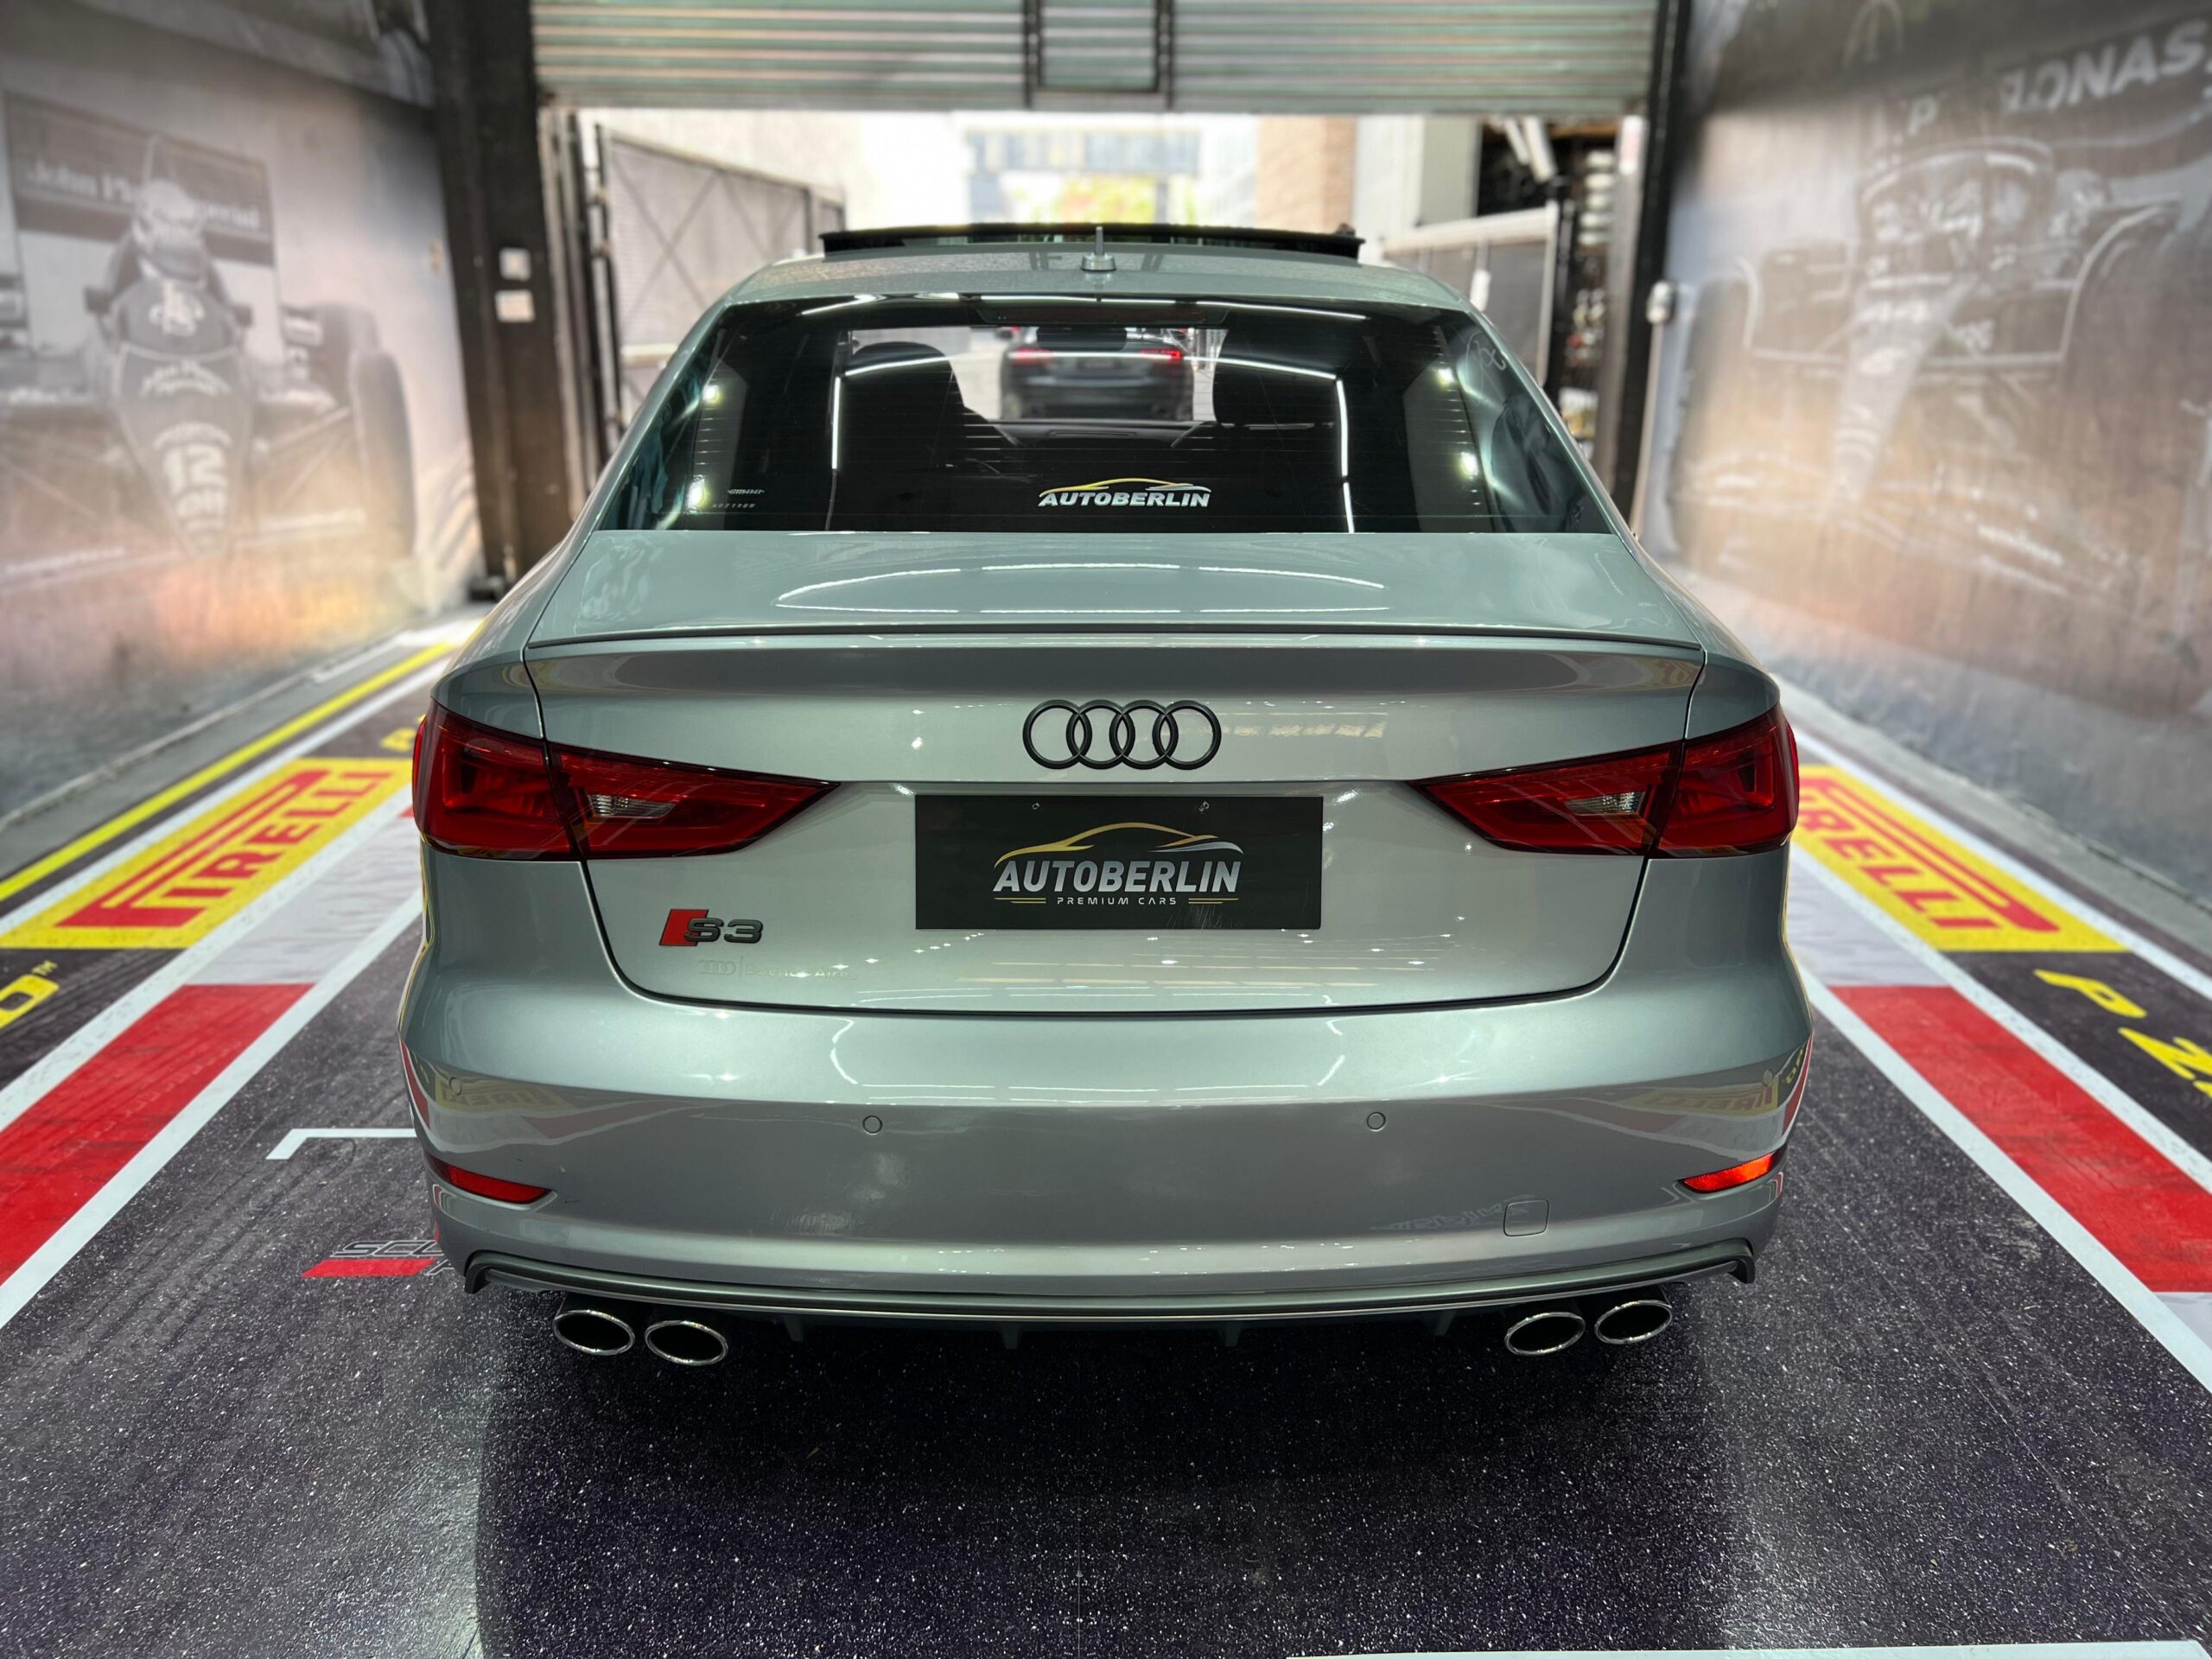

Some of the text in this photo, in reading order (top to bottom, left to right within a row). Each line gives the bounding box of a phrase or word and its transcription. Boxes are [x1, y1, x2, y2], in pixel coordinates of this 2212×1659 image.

[1038, 493, 1210, 506] AUTOBERLIN
[53, 769, 395, 927] PIRELLI
[993, 861, 1242, 893] AUTOBERLIN
[684, 918, 763, 944] S3
